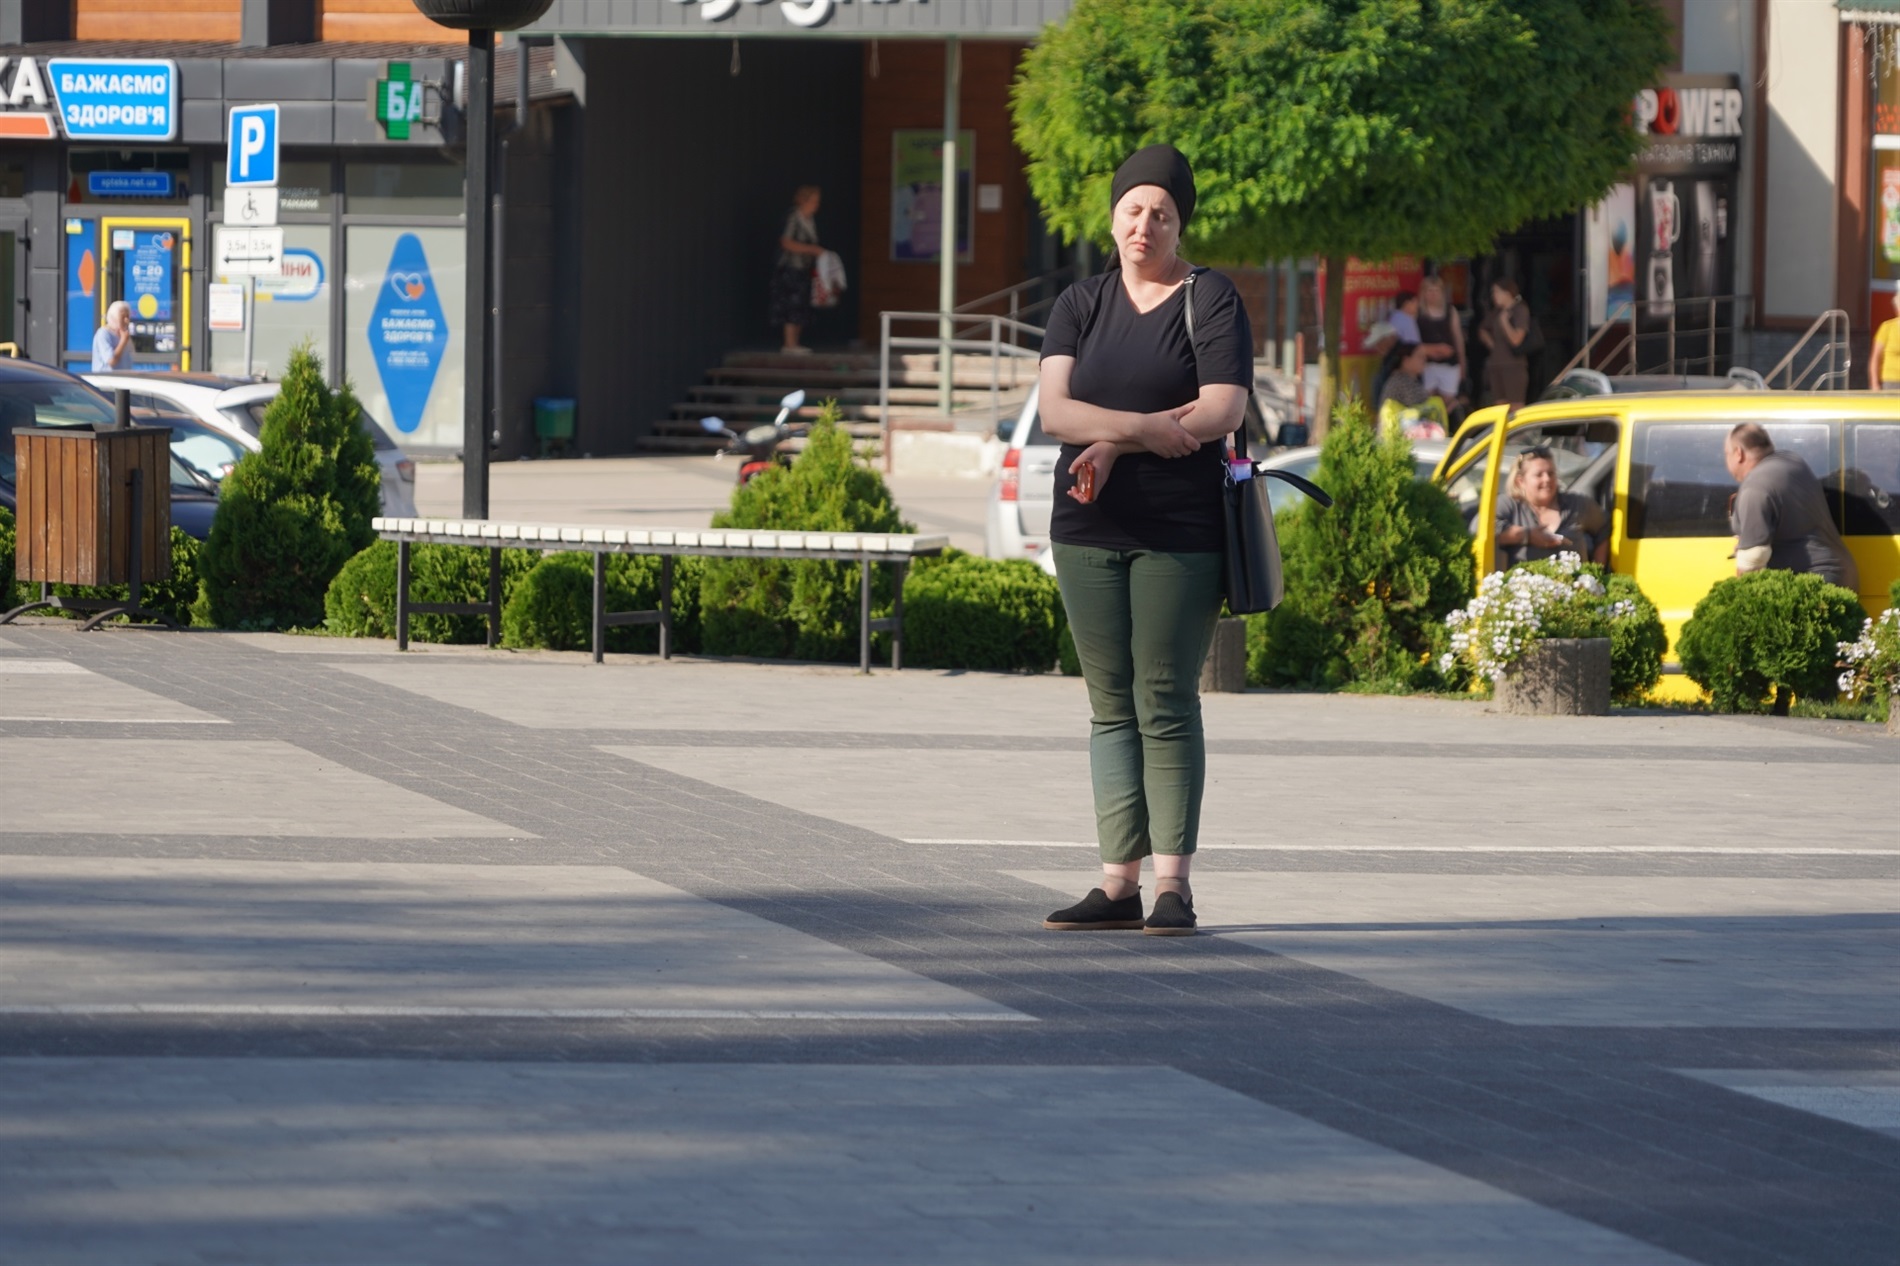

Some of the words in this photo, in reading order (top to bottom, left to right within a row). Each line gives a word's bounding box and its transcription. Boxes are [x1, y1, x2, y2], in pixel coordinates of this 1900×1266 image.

[61, 74, 167, 95] БАЖАЄМО
[387, 81, 421, 120] БА
[1634, 87, 1743, 136] POWER
[67, 105, 166, 128] ЗДОРОВ'Я
[239, 116, 266, 177] P
[1695, 143, 1736, 162] ТЕХНІКИ
[101, 177, 157, 189] apteka.net.ua
[1344, 275, 1400, 290] ЕНТРАЛЬНА
